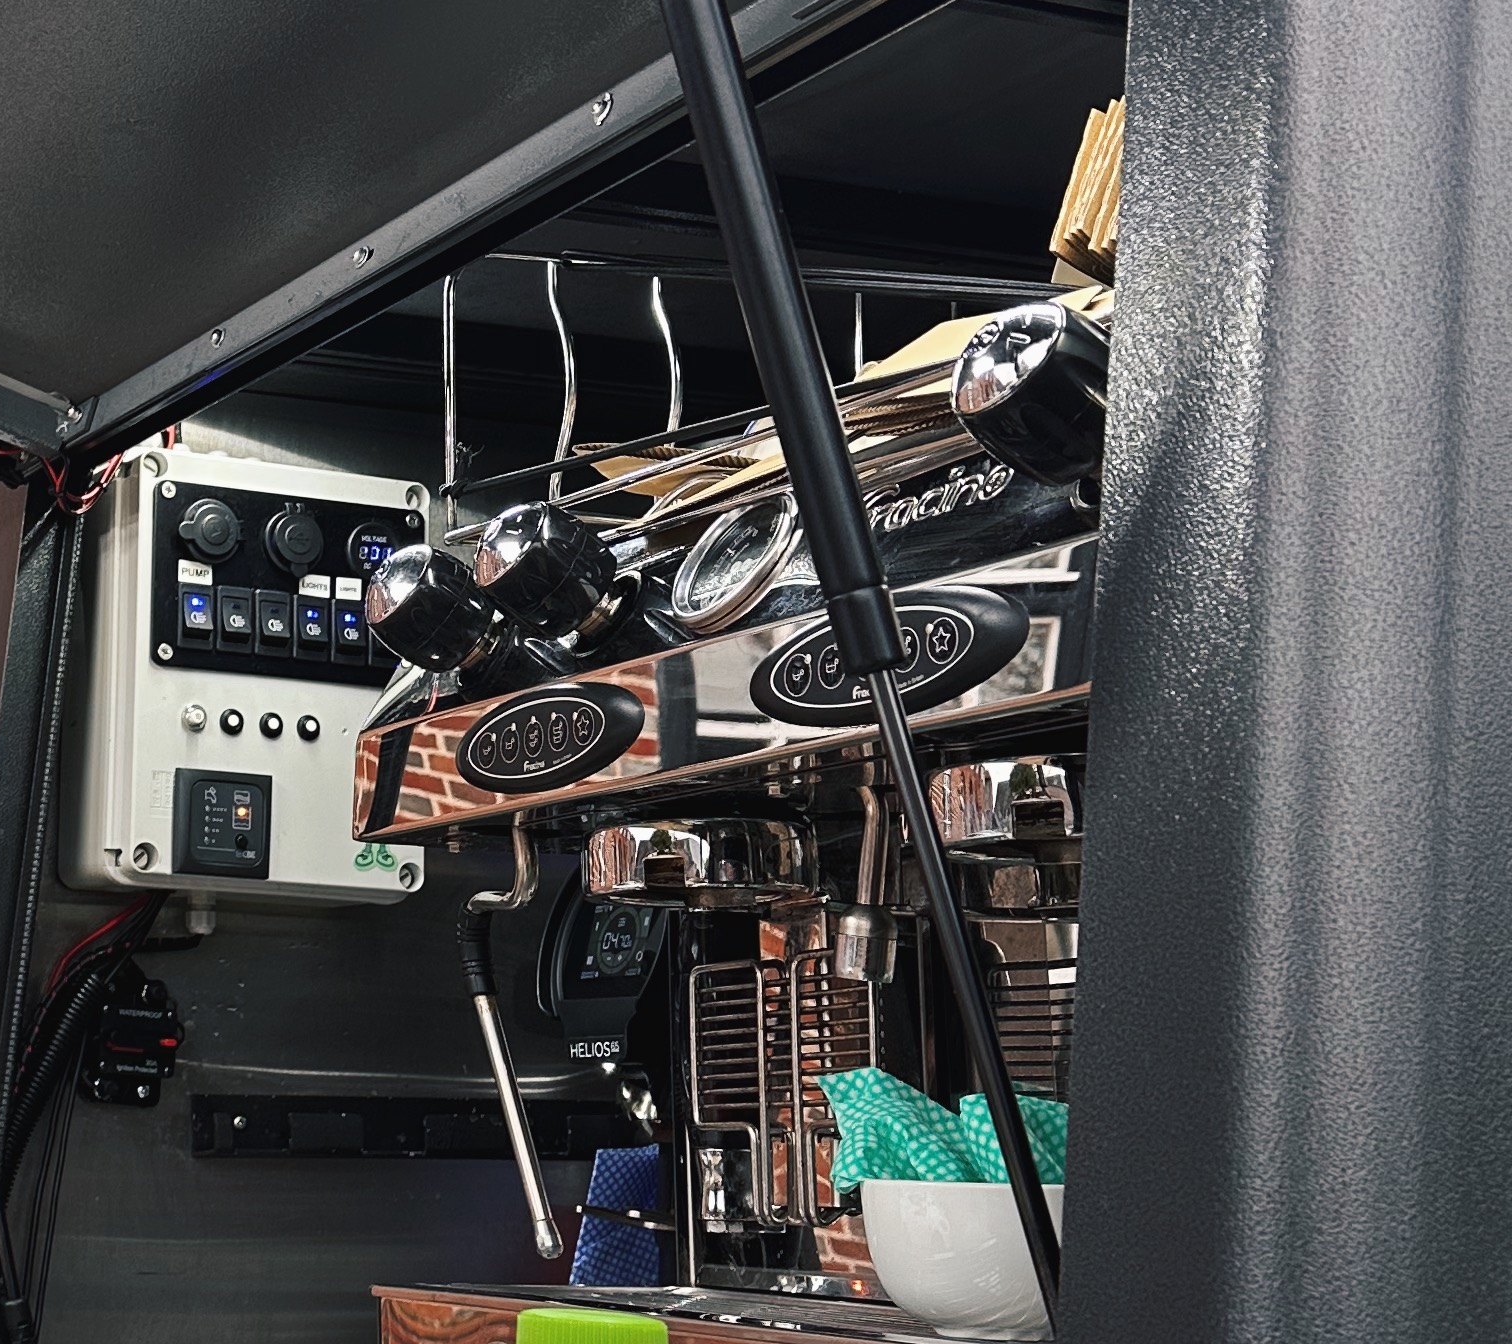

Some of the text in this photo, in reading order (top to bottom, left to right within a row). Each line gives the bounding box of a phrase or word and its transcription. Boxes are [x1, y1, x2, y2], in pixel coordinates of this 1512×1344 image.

[181, 567, 210, 578] PUMP
[301, 578, 328, 592] LIGHTS
[570, 1042, 610, 1058] HELIOS
